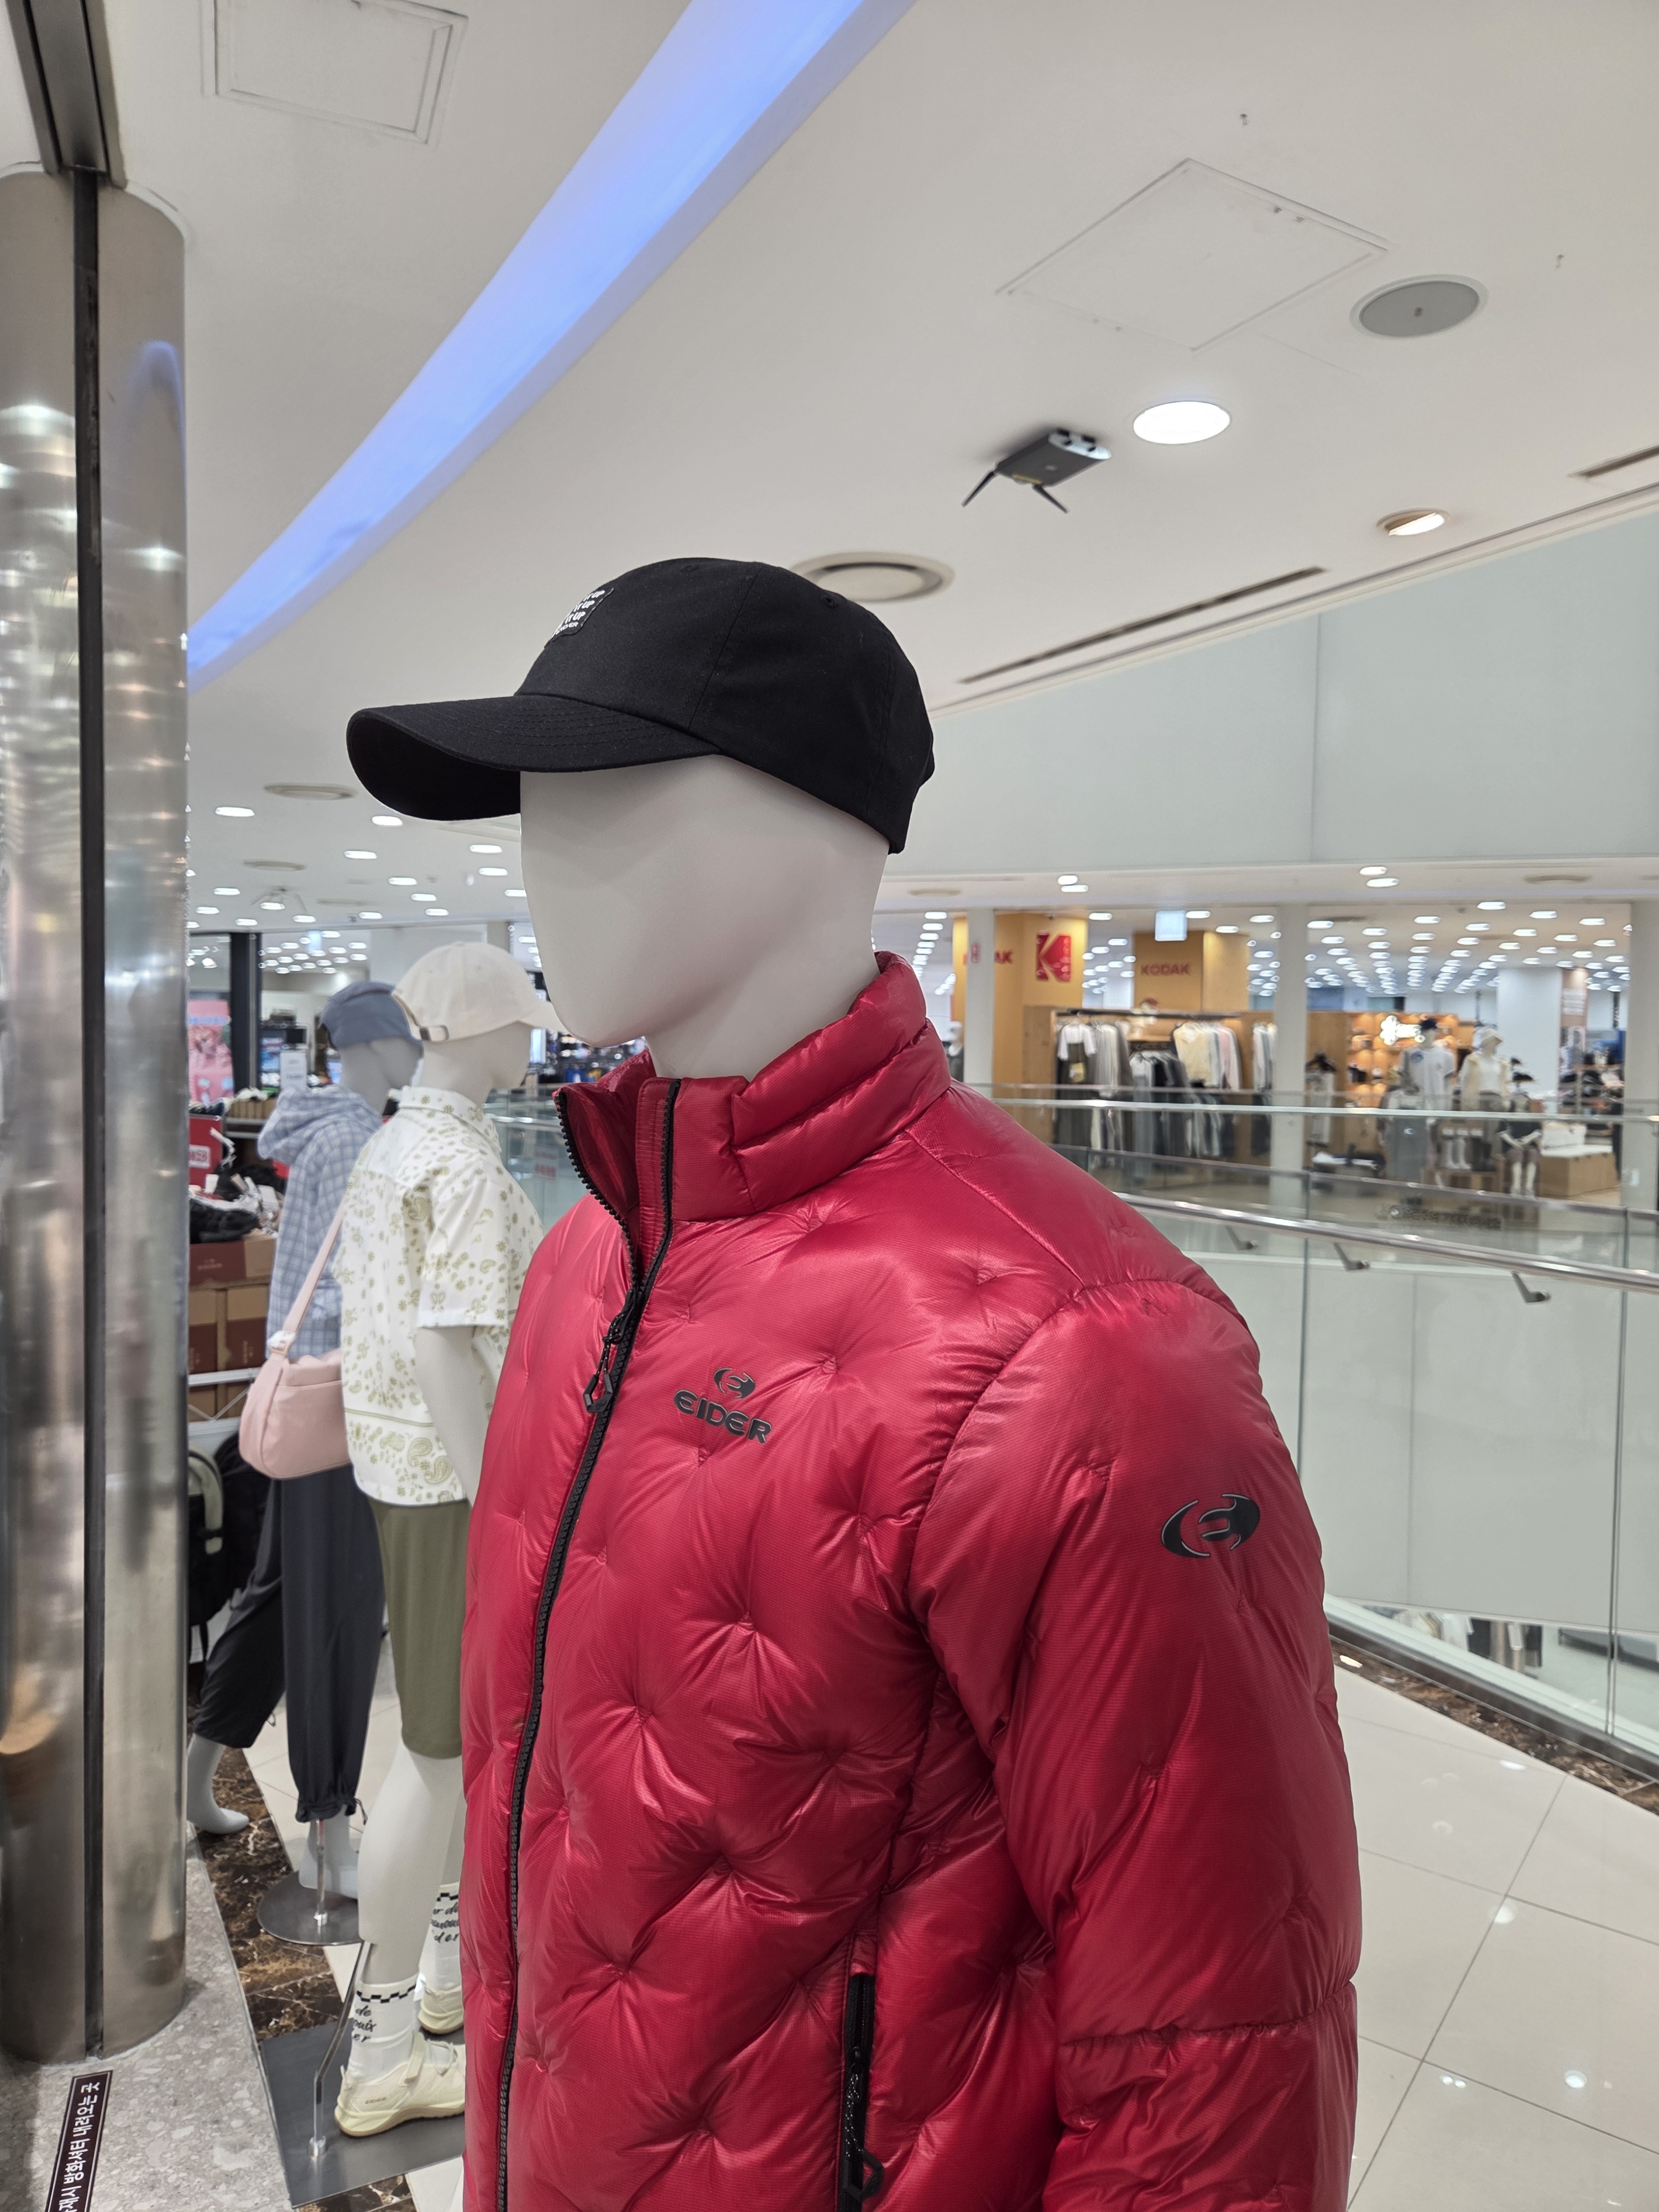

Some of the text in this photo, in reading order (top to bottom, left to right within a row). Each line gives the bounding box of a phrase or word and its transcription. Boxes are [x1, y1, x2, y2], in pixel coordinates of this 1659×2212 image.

[591, 590, 605, 598] UP
[581, 600, 595, 609] UP
[565, 612, 586, 624] IT UP
[1141, 963, 1190, 975] KODAK
[674, 1390, 772, 1444] EIDER
[59, 2081, 101, 2212] 재시 방화셔터 내려오는 곳
